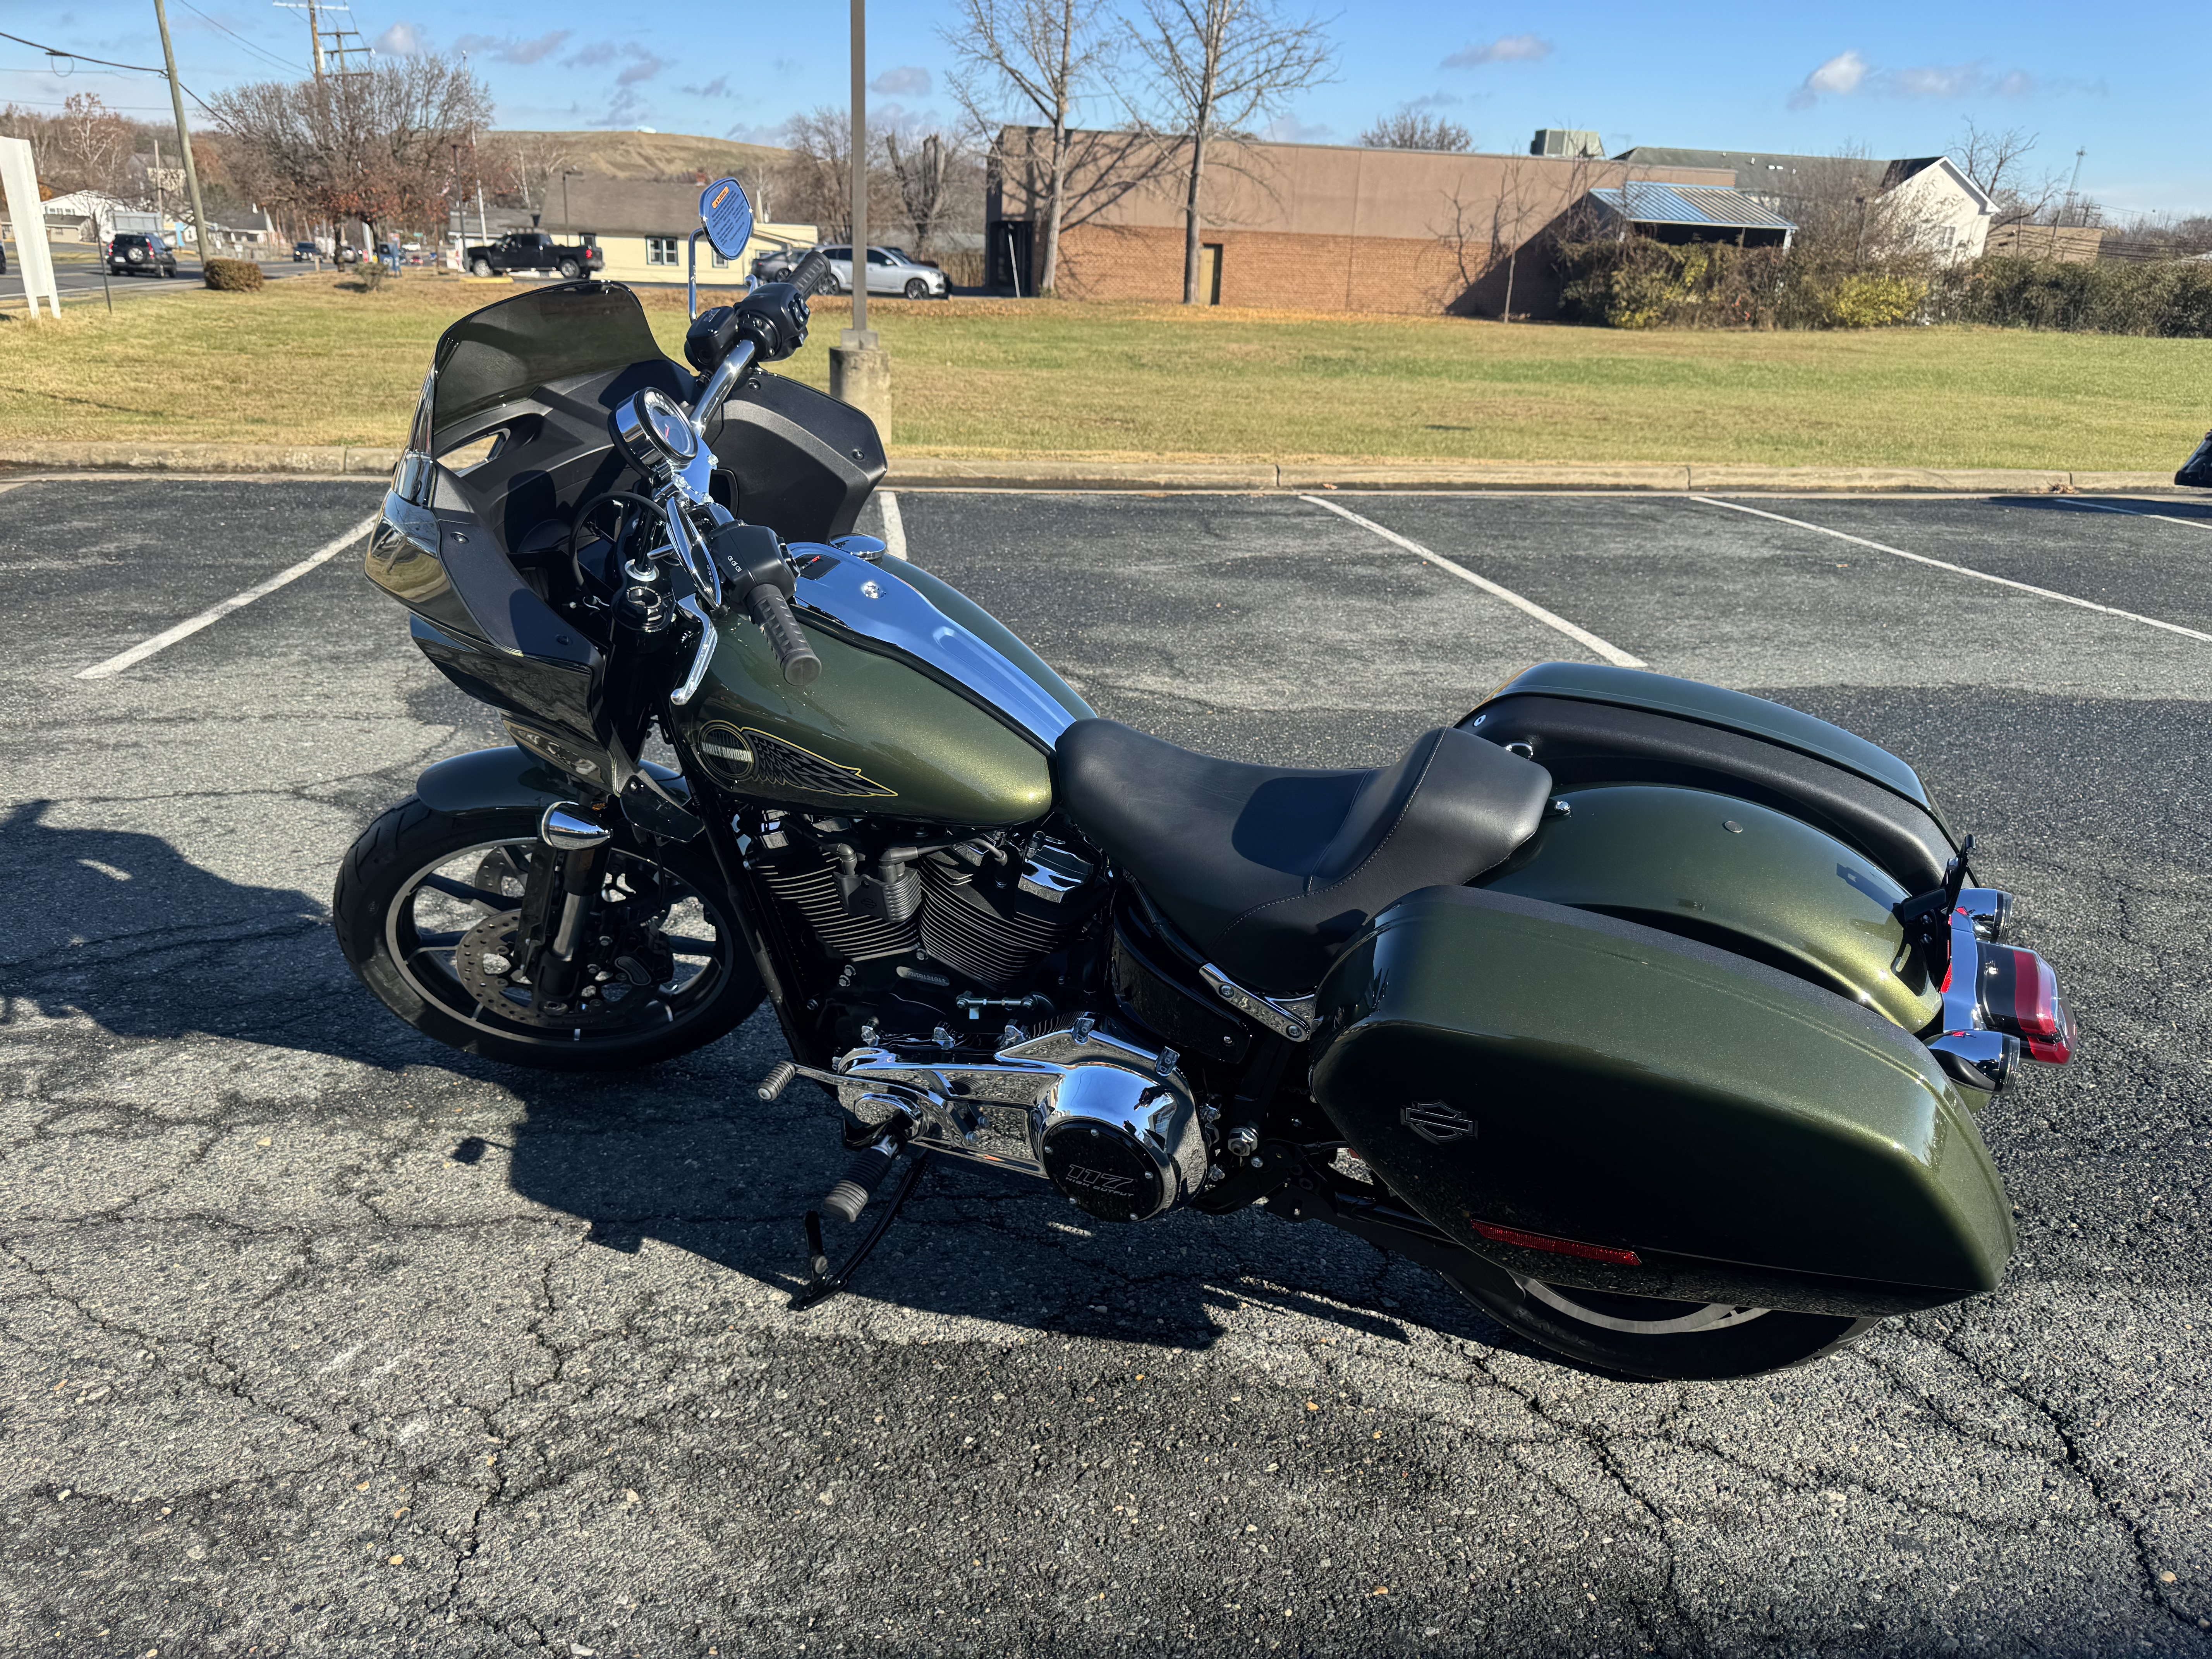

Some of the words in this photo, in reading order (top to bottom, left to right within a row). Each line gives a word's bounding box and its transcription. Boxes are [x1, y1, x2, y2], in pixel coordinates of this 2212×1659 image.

[702, 742, 752, 762] HARLEY-DAVIDSON
[1065, 1176, 1090, 1187] HIGH
[1093, 1185, 1134, 1197] OUTPUT
[1067, 1164, 1134, 1189] 117
